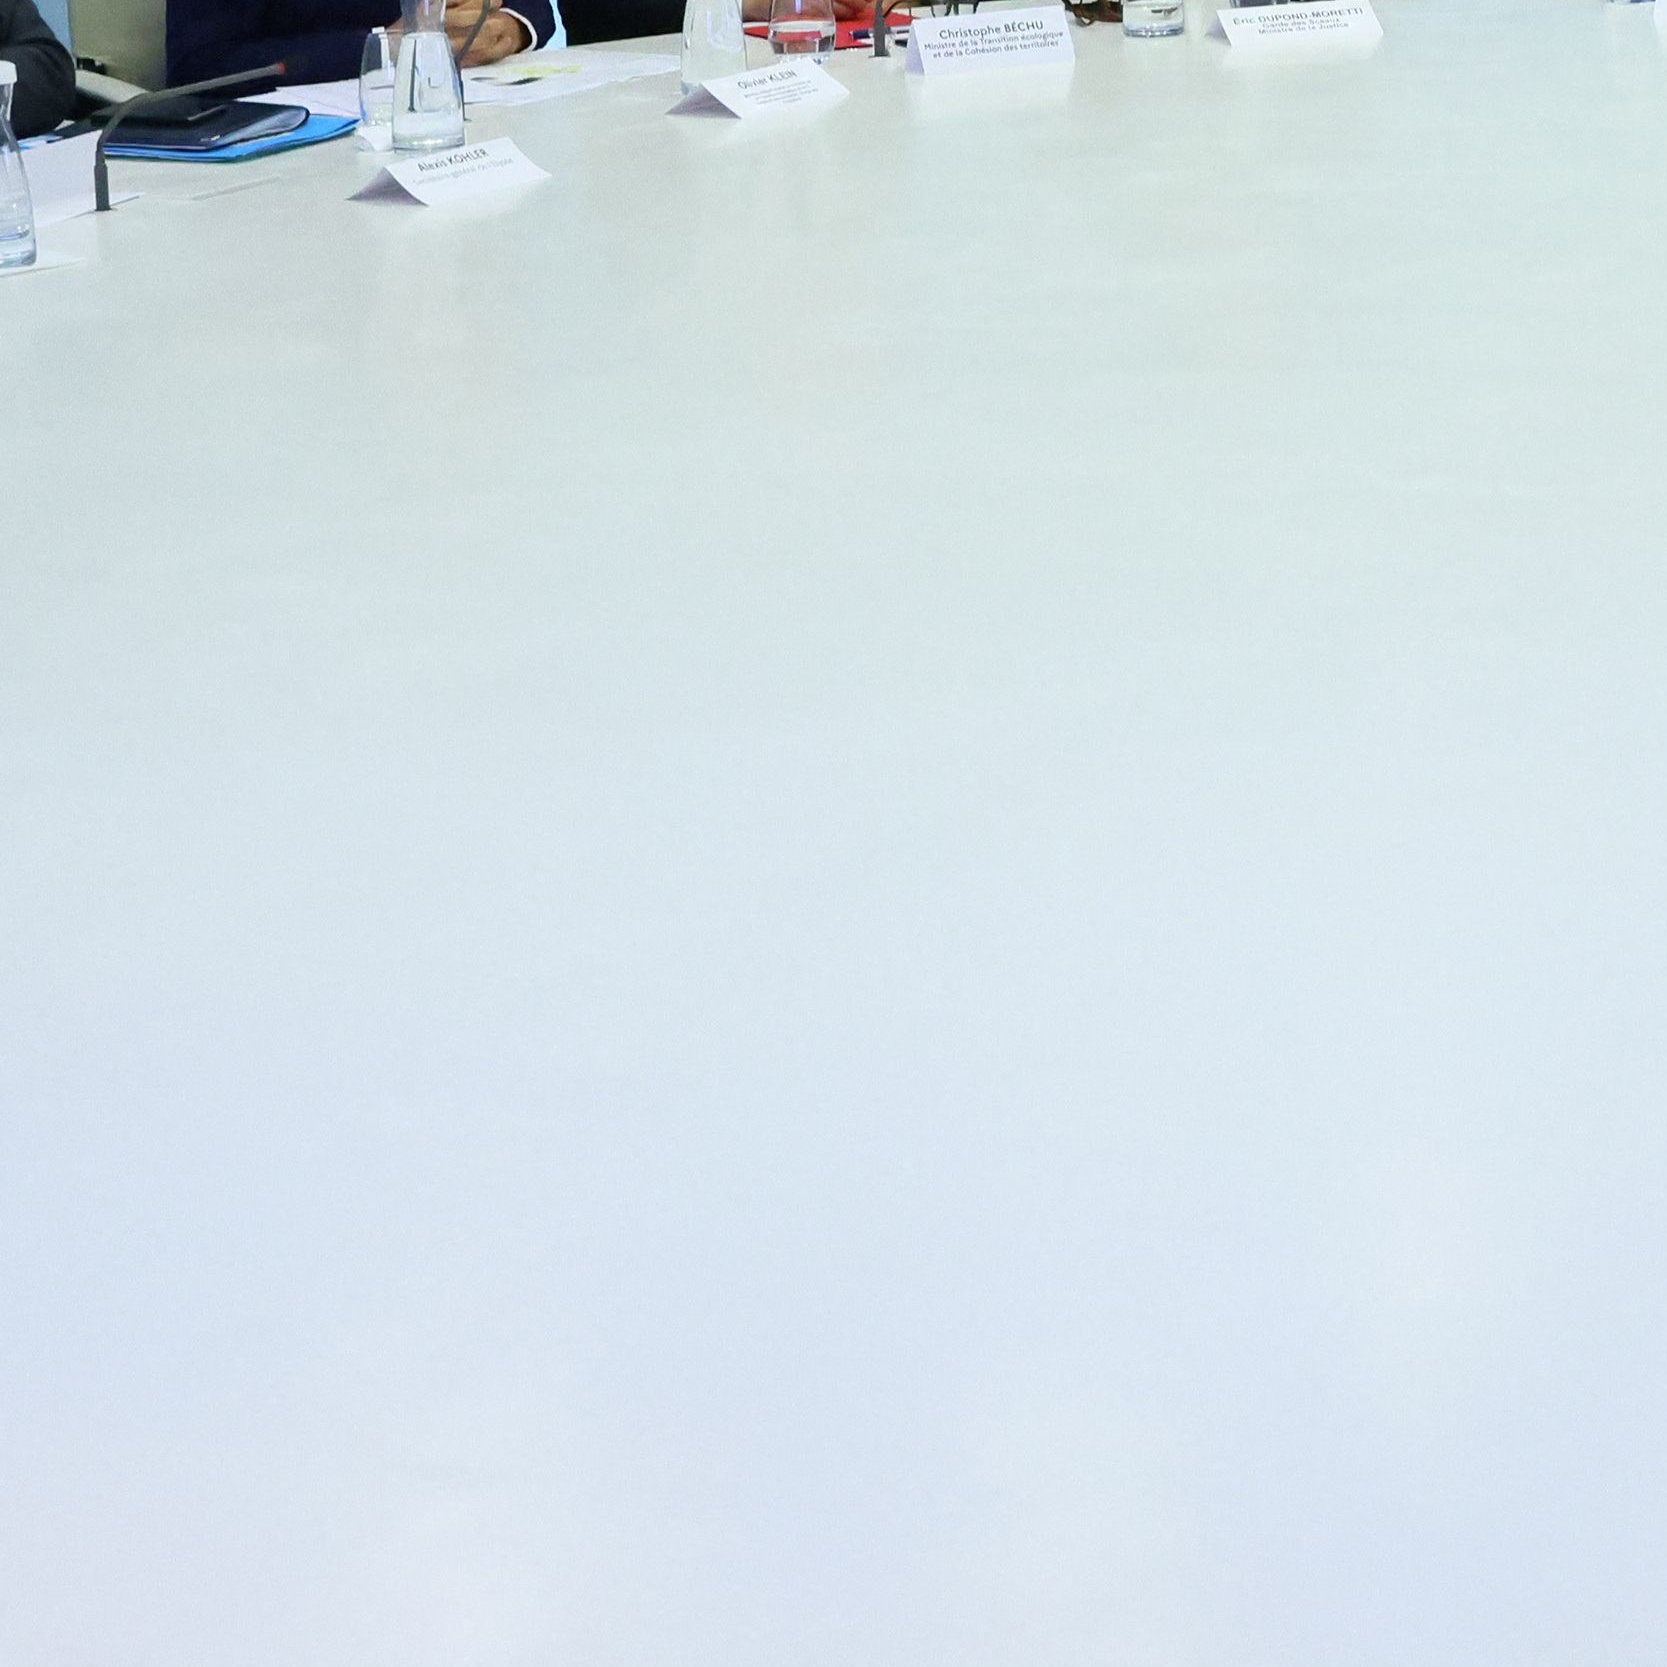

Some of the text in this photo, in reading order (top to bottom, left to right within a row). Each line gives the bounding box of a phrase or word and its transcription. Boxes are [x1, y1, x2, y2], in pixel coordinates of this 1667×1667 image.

[1258, 7, 1363, 23] DUPOND-MORETTI
[939, 20, 1044, 40] Christophe BÉCHU
[924, 31, 1064, 51] Ministre de la Transition écologique
[943, 50, 954, 58] de
[956, 49, 963, 57] la
[965, 44, 1002, 56] Cohésion
[1004, 43, 1018, 52] des
[1020, 40, 1059, 51] territoires
[737, 70, 797, 89] Olivier KLEIN
[418, 148, 489, 172] Alexis KOHLER
